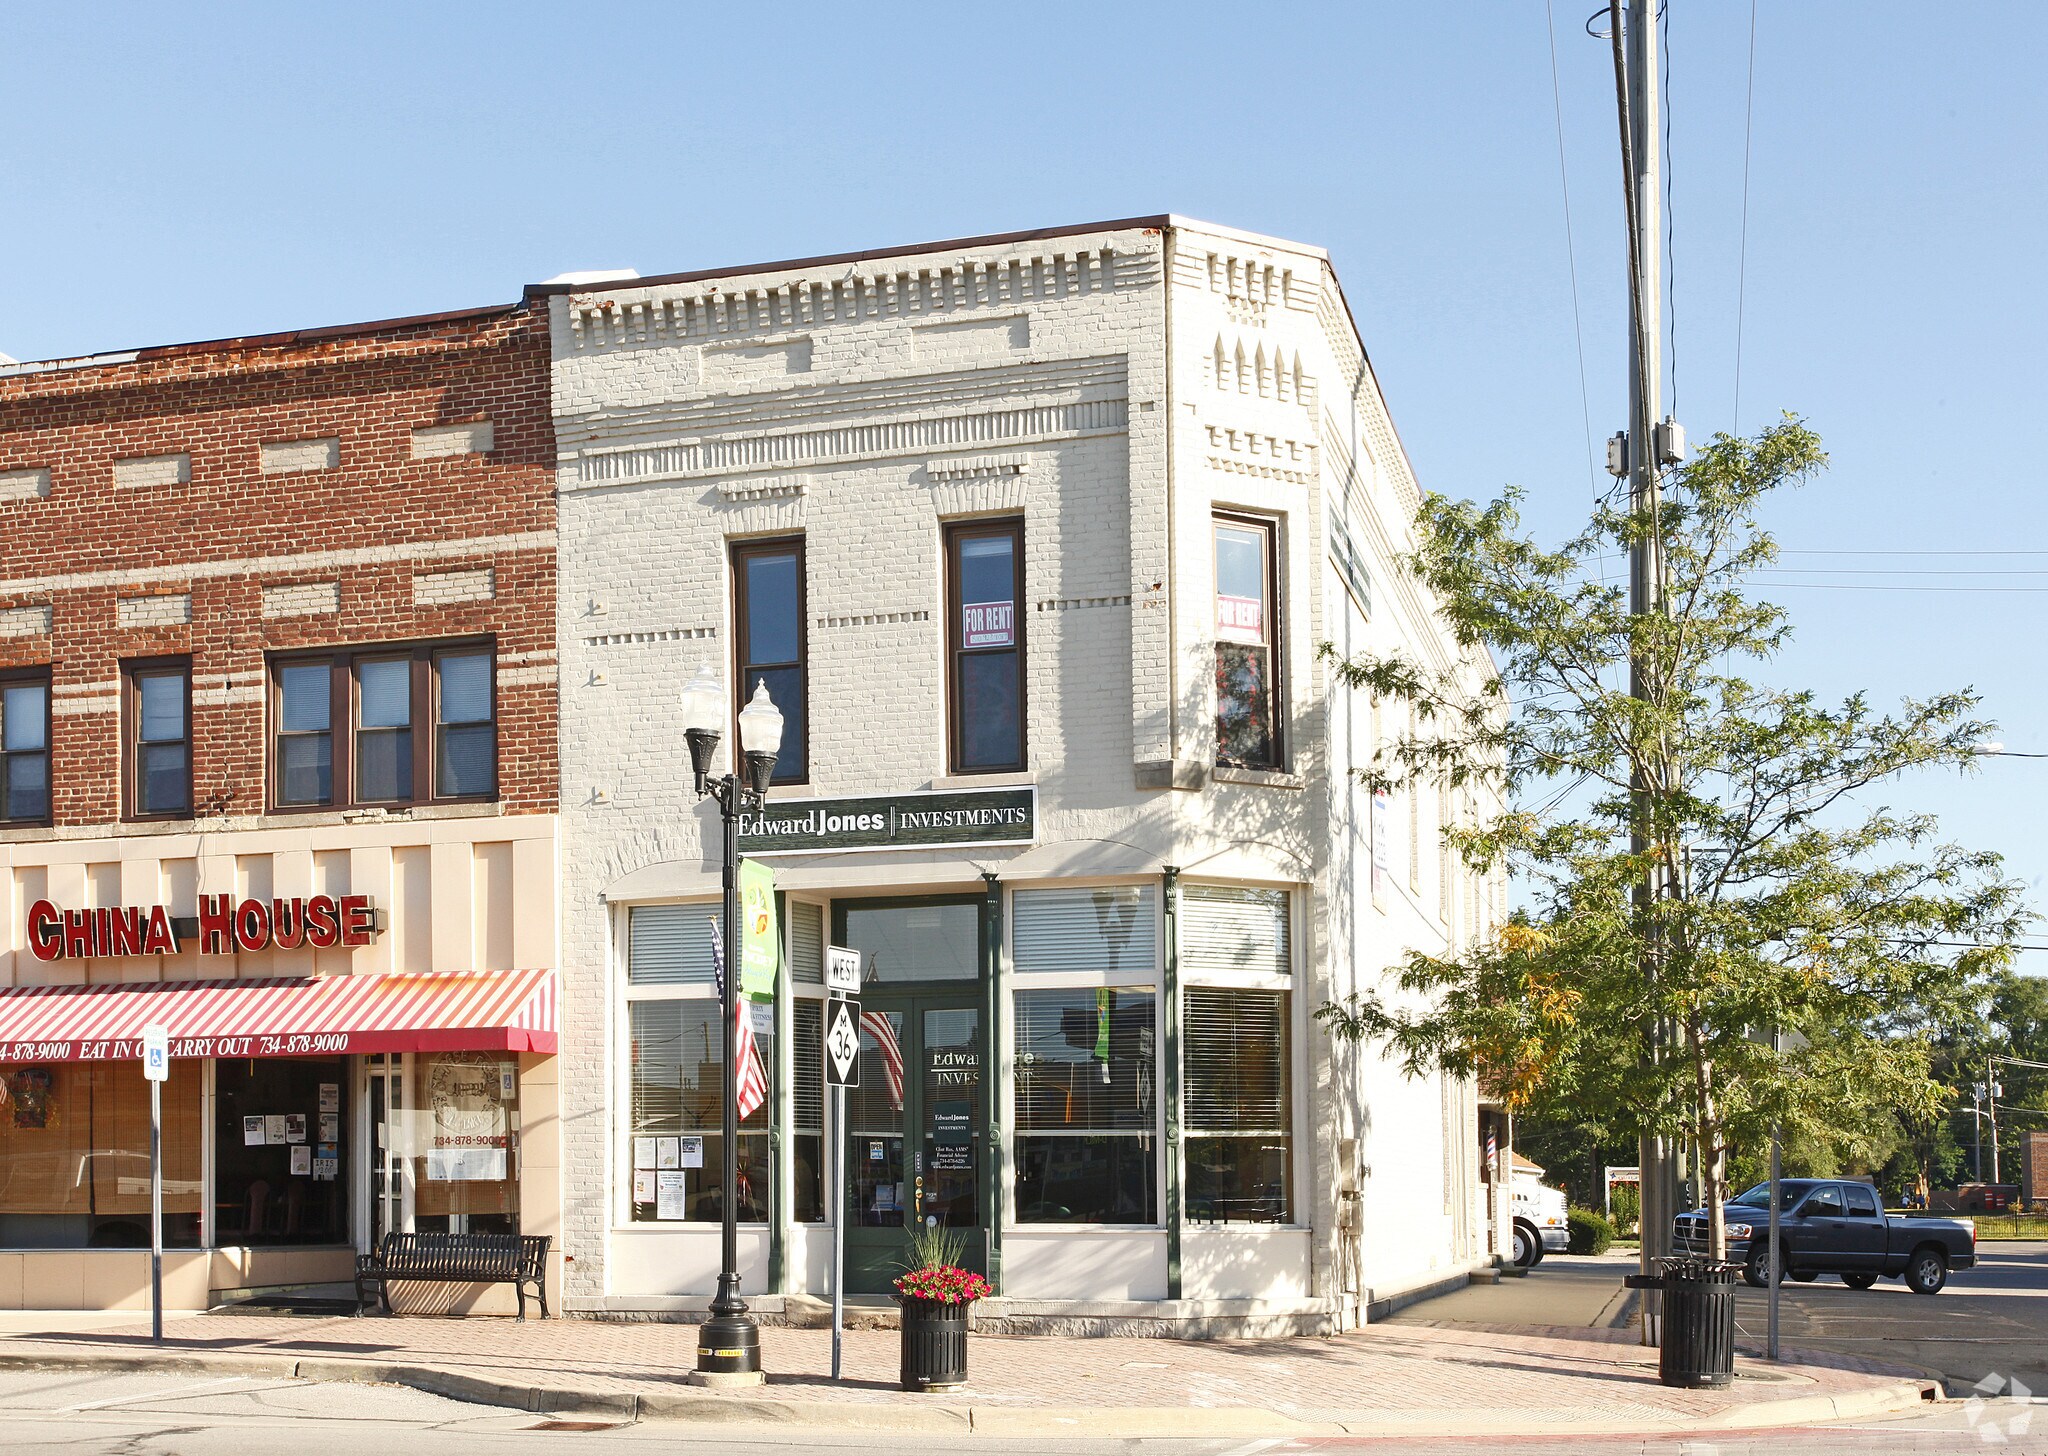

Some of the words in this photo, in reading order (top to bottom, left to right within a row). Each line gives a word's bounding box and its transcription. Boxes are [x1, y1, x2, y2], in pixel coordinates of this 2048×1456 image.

[965, 608, 984, 632] FOR
[986, 606, 1012, 630] RENT
[900, 807, 1027, 829] INVESTMENTS
[26, 898, 182, 962] CHINA
[198, 893, 375, 955] HOUSE
[832, 957, 856, 983] WEST
[839, 1014, 848, 1028] M
[78, 1041, 110, 1059] EAT
[112, 1041, 131, 1058] IN
[168, 1037, 216, 1057] CARRY
[217, 1036, 253, 1056] OUT
[258, 1033, 349, 1054] 734-878-9000
[834, 1029, 852, 1061] 36
[433, 1135, 502, 1146] 734-878-9000
[315, 1159, 334, 1167] IRIS
